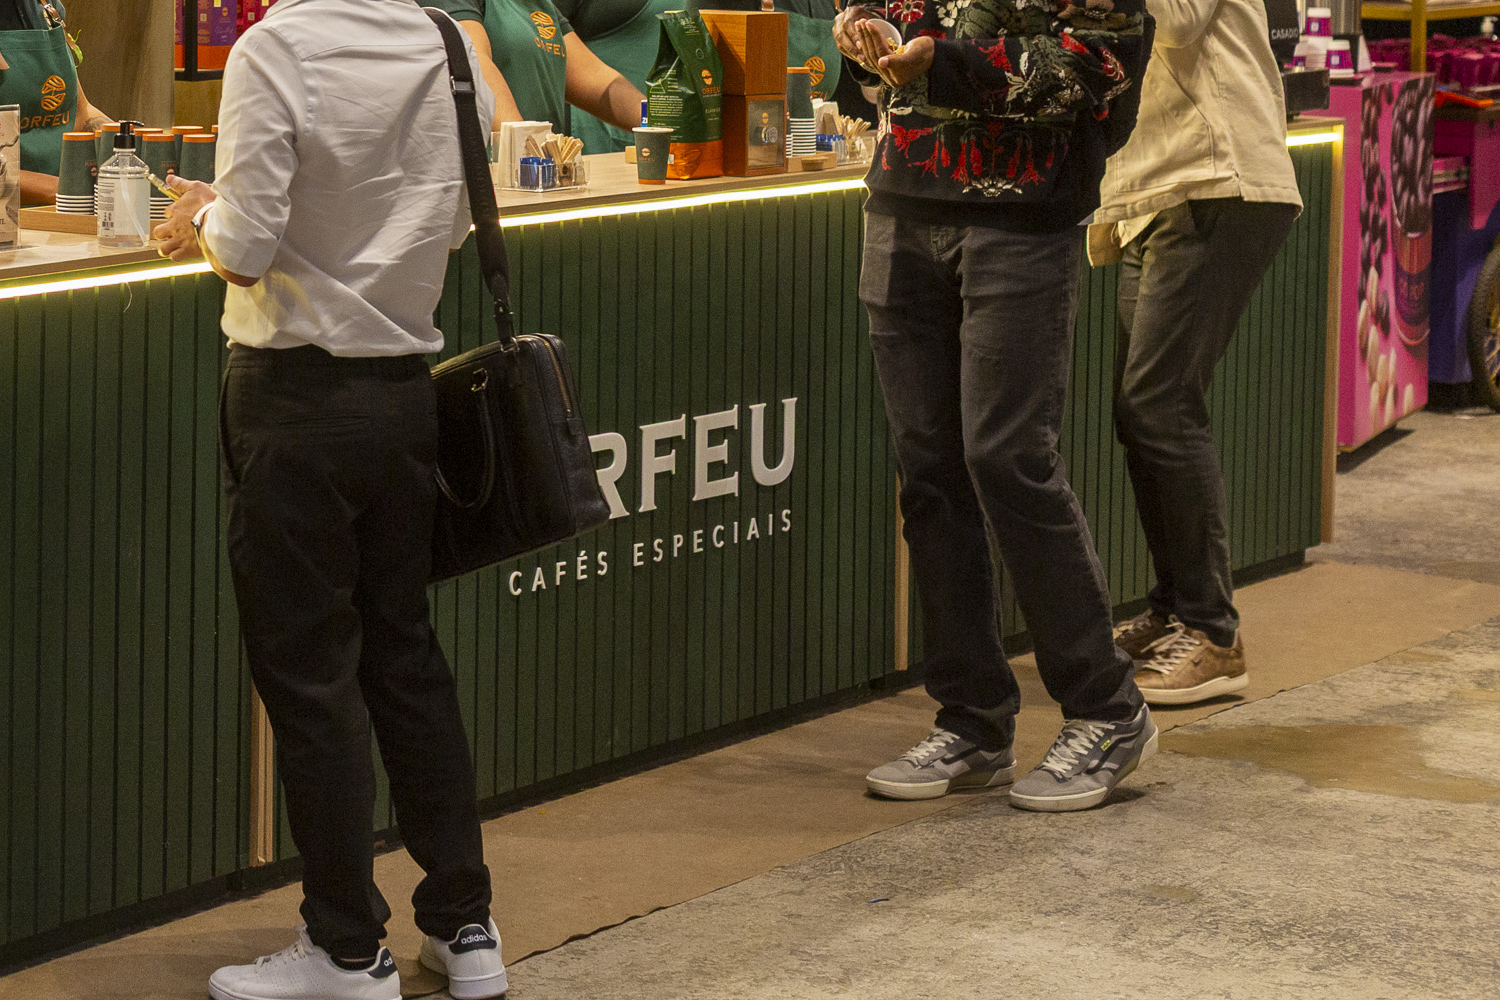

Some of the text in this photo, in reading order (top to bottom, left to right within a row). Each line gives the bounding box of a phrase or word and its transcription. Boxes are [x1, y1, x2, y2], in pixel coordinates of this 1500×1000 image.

[20, 111, 70, 129] ORFEU
[588, 397, 798, 520] RFEU
[509, 509, 792, 596] CAFÉS ESPECIAIS
[461, 933, 487, 945] adidas
